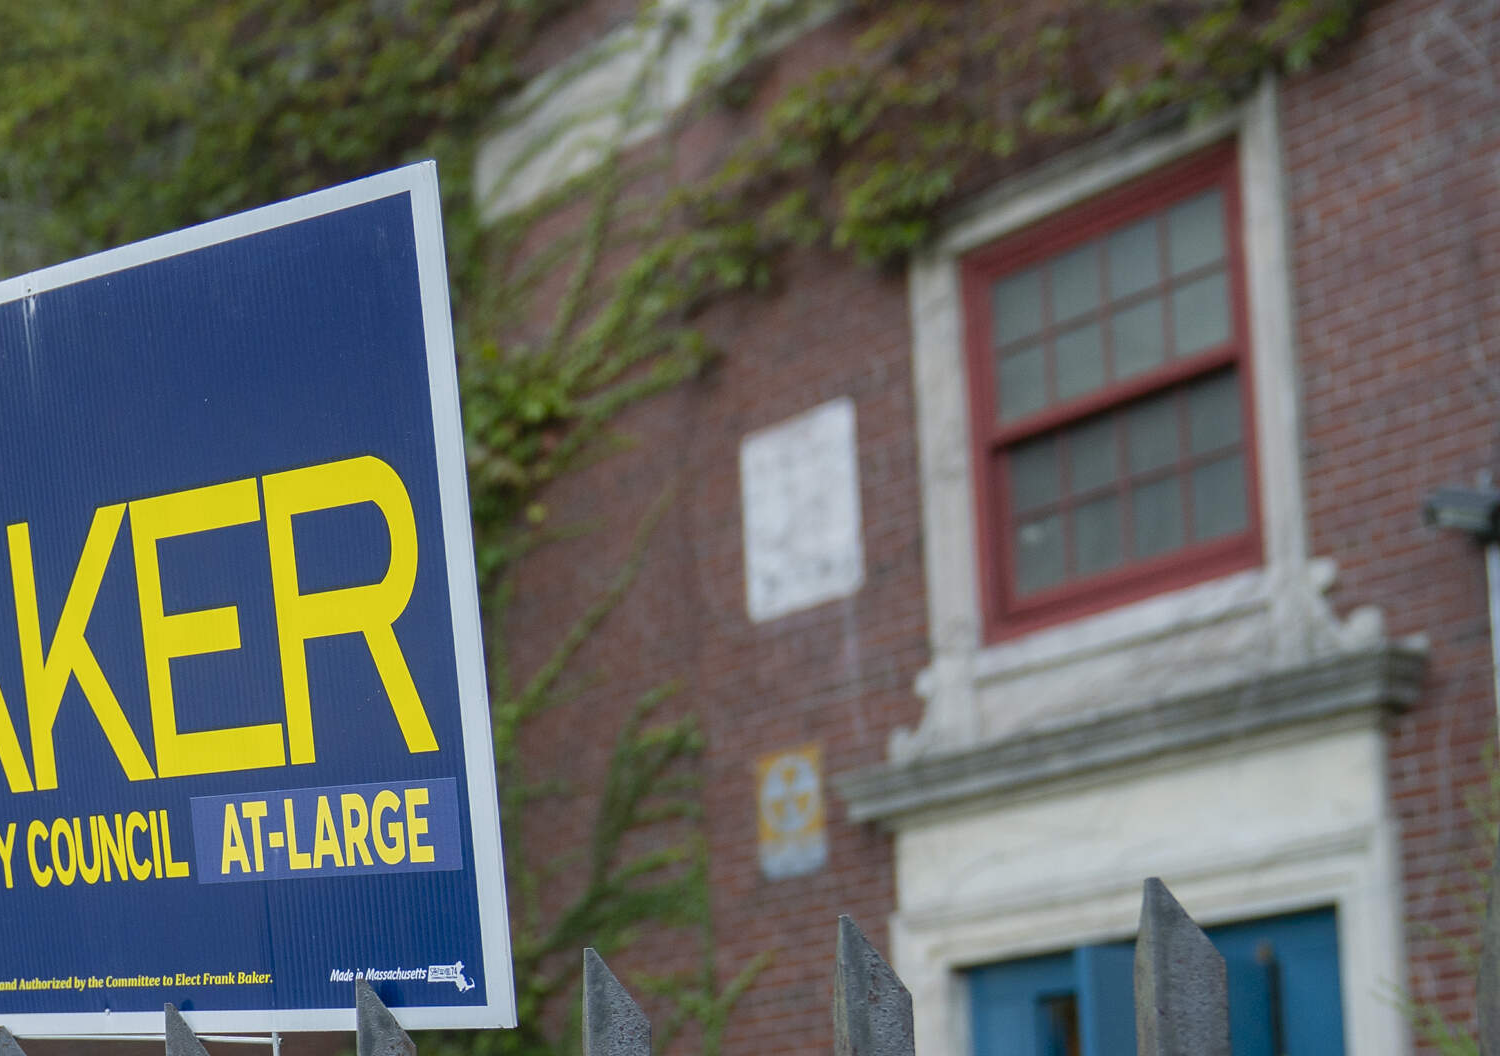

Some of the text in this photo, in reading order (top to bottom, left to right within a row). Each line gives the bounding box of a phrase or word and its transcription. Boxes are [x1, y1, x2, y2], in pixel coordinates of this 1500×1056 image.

[27, 810, 189, 887] COUNCIL
[221, 787, 434, 875] AT-LARGE
[19, 977, 72, 990] Authorized
[74, 976, 86, 991] by
[88, 976, 104, 988] the
[106, 974, 160, 988] Committee
[162, 975, 173, 986] to
[175, 973, 201, 986] Elect
[203, 972, 235, 985] Frank
[237, 971, 273, 984] Baker.
[330, 968, 354, 982] Made
[356, 967, 364, 980] in
[365, 966, 427, 981] Massachusetts
